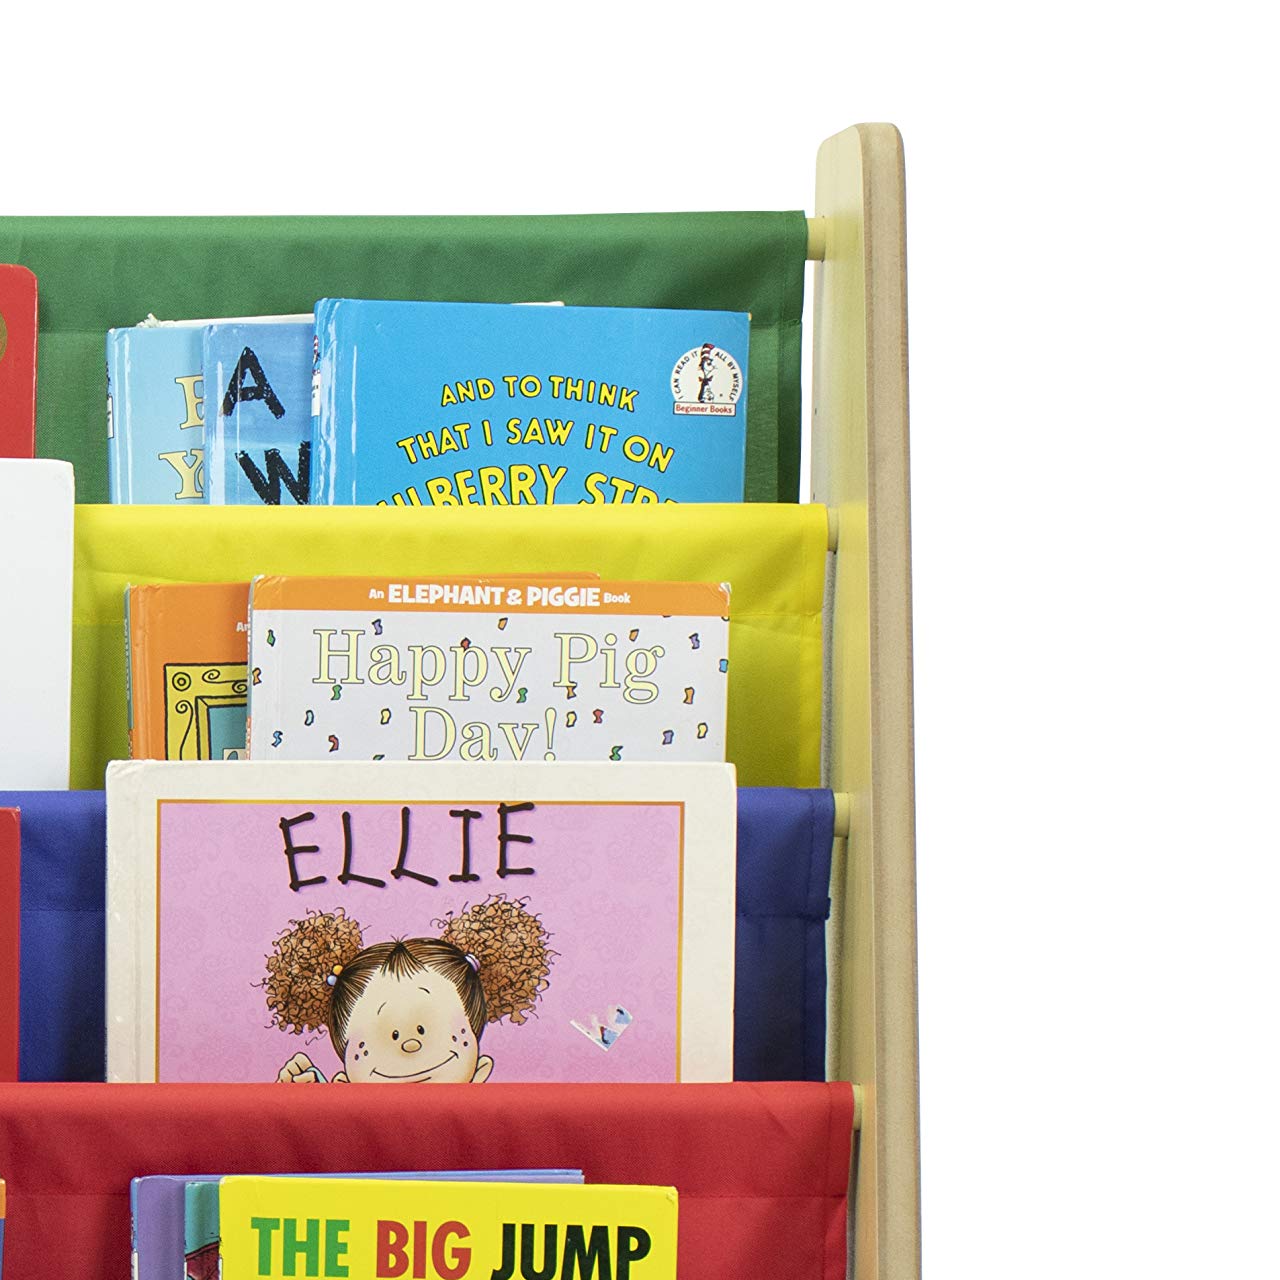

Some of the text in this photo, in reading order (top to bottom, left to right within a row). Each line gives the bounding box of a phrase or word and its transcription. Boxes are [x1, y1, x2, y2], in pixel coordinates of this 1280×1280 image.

[675, 355, 690, 374] READ
[714, 351, 739, 402] ALL BY MYSELF
[440, 375, 639, 413] AND TO THINK
[675, 404, 732, 414] Beginner Books
[396, 417, 675, 474] THAT I SAW IT ON
[369, 583, 631, 607] An ELEPHANT & PIGGIE Book
[312, 628, 533, 703] Happy
[552, 630, 667, 704] Pig
[279, 801, 536, 892] ELLIE
[251, 1216, 350, 1278] THE
